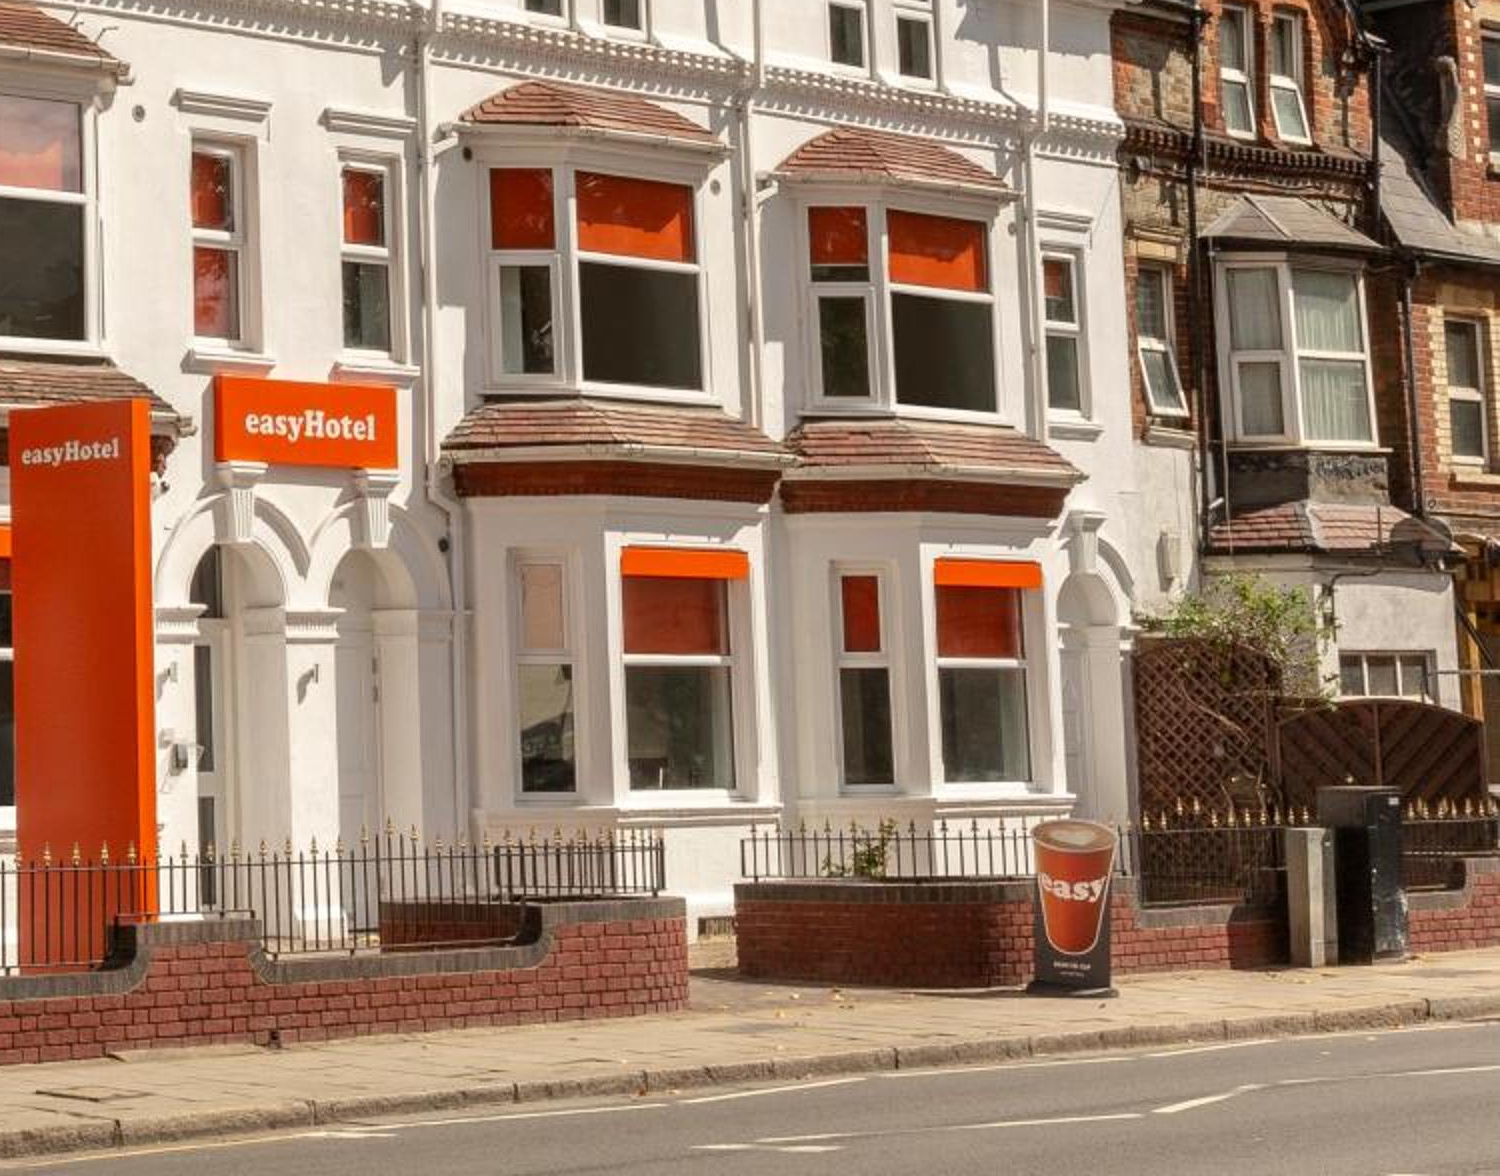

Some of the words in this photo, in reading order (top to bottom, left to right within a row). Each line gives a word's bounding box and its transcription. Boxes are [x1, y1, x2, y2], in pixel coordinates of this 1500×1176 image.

[245, 409, 375, 443] easyHotel
[21, 437, 119, 467] easyHotel
[1040, 873, 1107, 903] easy
